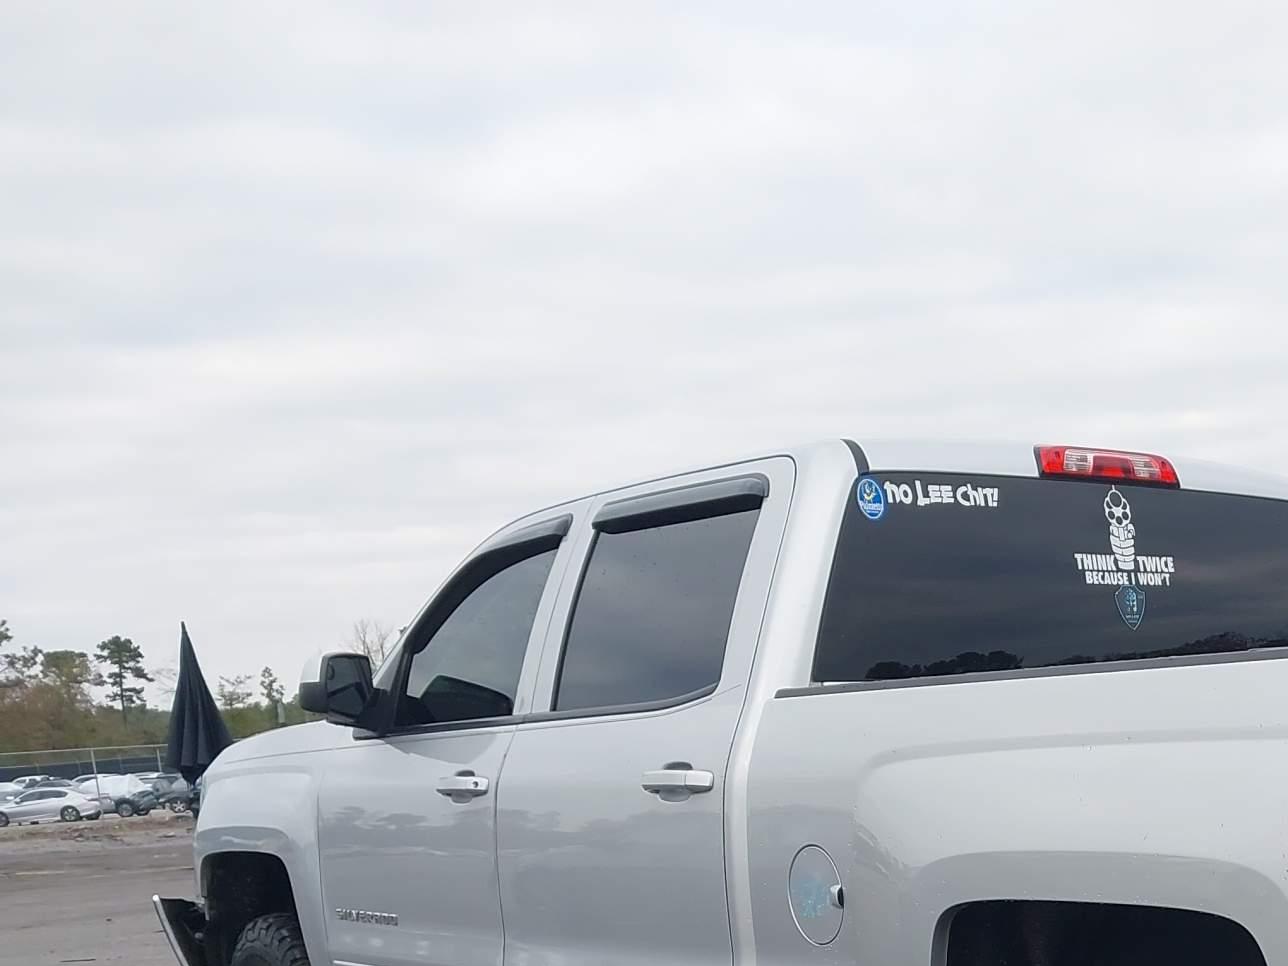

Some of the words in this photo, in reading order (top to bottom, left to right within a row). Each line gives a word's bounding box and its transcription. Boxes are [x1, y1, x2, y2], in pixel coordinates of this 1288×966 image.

[914, 480, 955, 507] LEE
[1073, 553, 1117, 572] THINK
[1136, 555, 1175, 573] TWICE
[1085, 571, 1129, 585] BECAUSE
[1131, 572, 1136, 586] I
[1137, 572, 1170, 587] WON'T
[335, 907, 399, 928] SILVERADO
